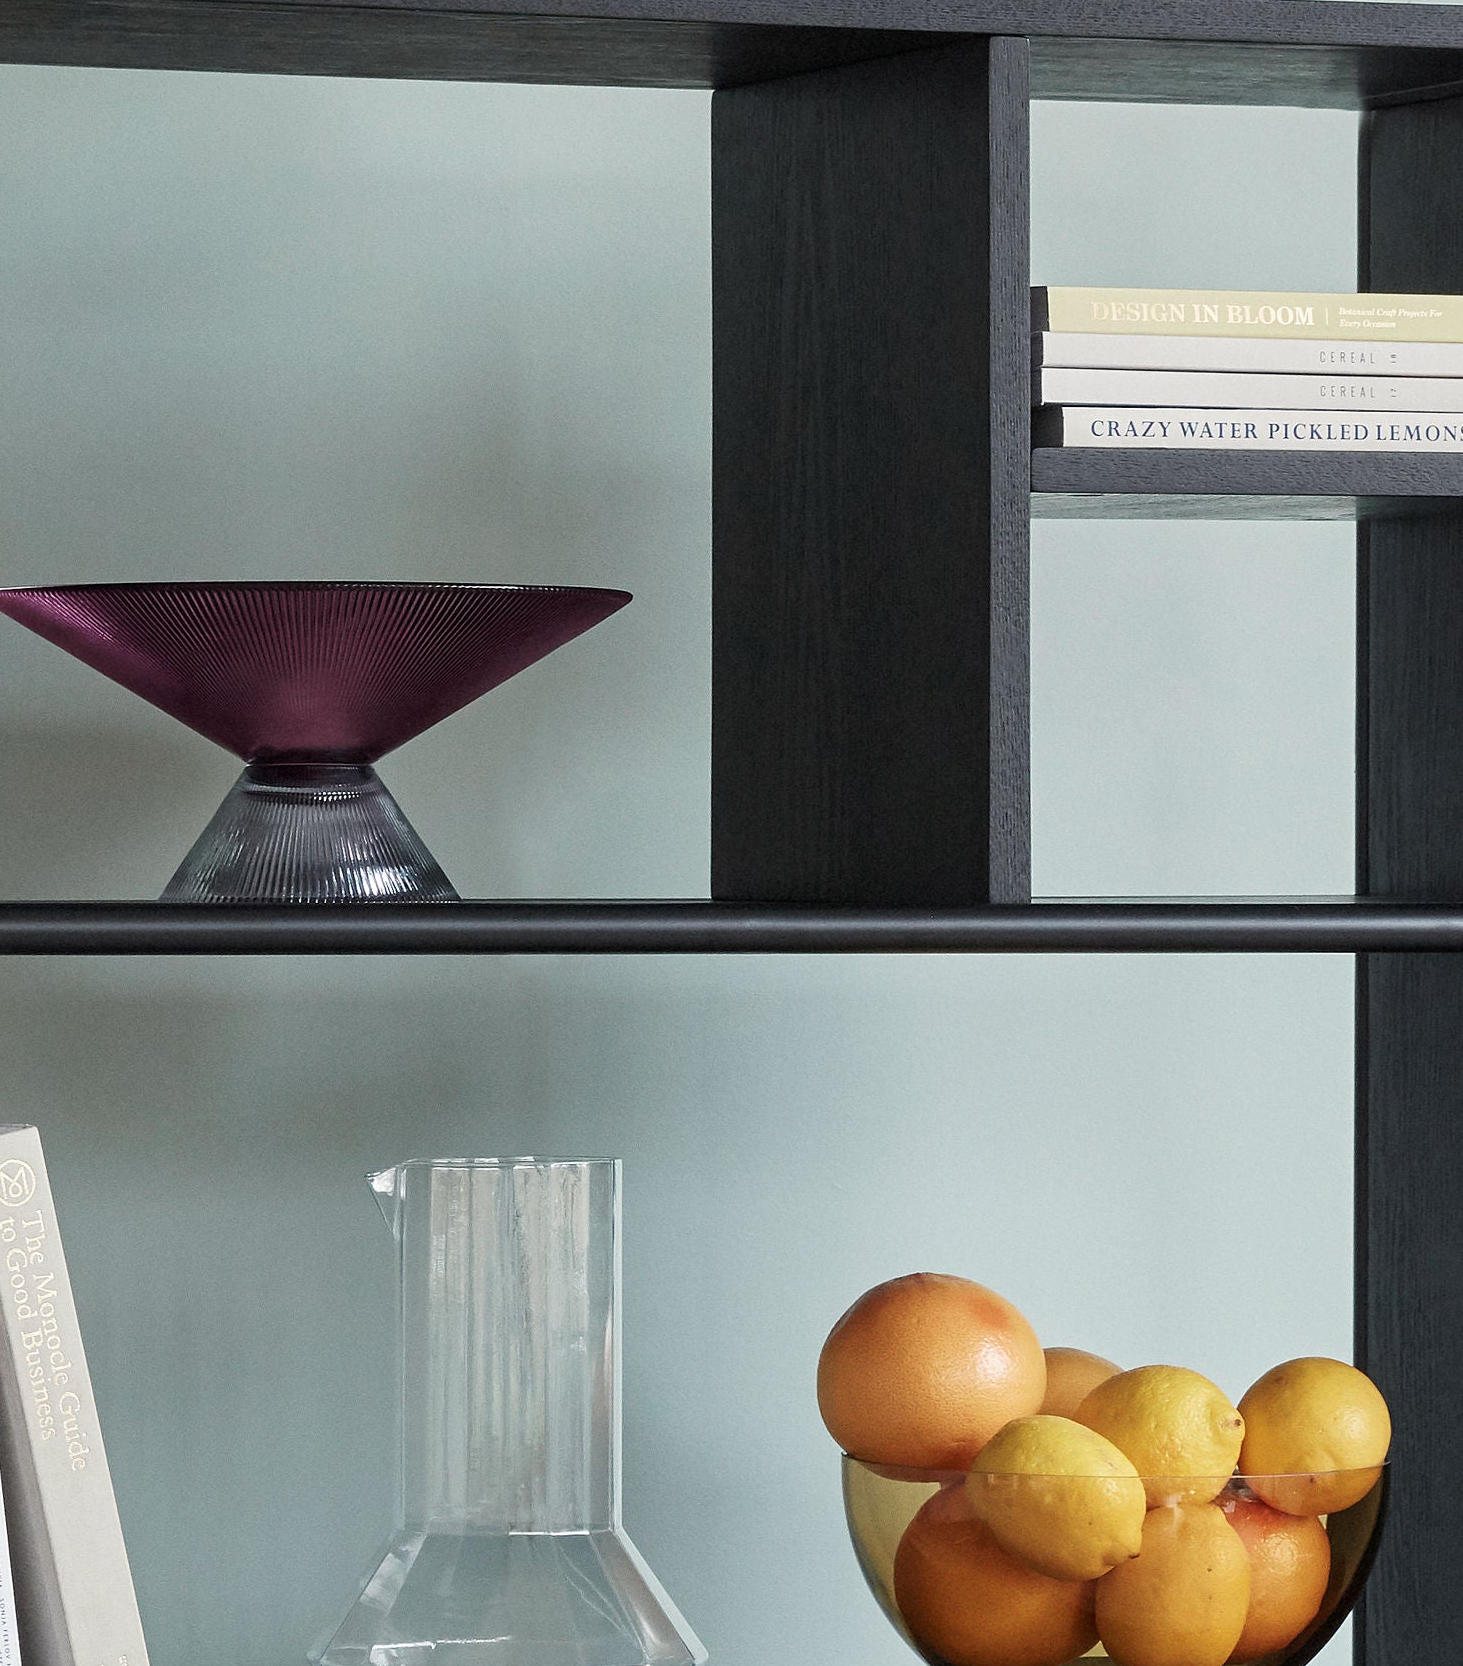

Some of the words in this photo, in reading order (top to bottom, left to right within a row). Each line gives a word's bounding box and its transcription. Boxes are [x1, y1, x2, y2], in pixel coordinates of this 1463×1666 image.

[1090, 301, 1185, 323] DESIGN
[1192, 304, 1219, 324] IN
[1225, 304, 1315, 326] BLOOM
[1319, 351, 1375, 364] CEREAL
[1320, 385, 1376, 398] CEREAL
[1091, 420, 1172, 437] CRAZY
[1179, 421, 1258, 439] WATER
[1268, 423, 1368, 440] PICKLED
[21, 1211, 46, 1264] The
[6, 1248, 35, 1321] Good
[21, 1328, 57, 1441] Business
[33, 1273, 72, 1386] Monocle
[59, 1391, 90, 1471] Guide
